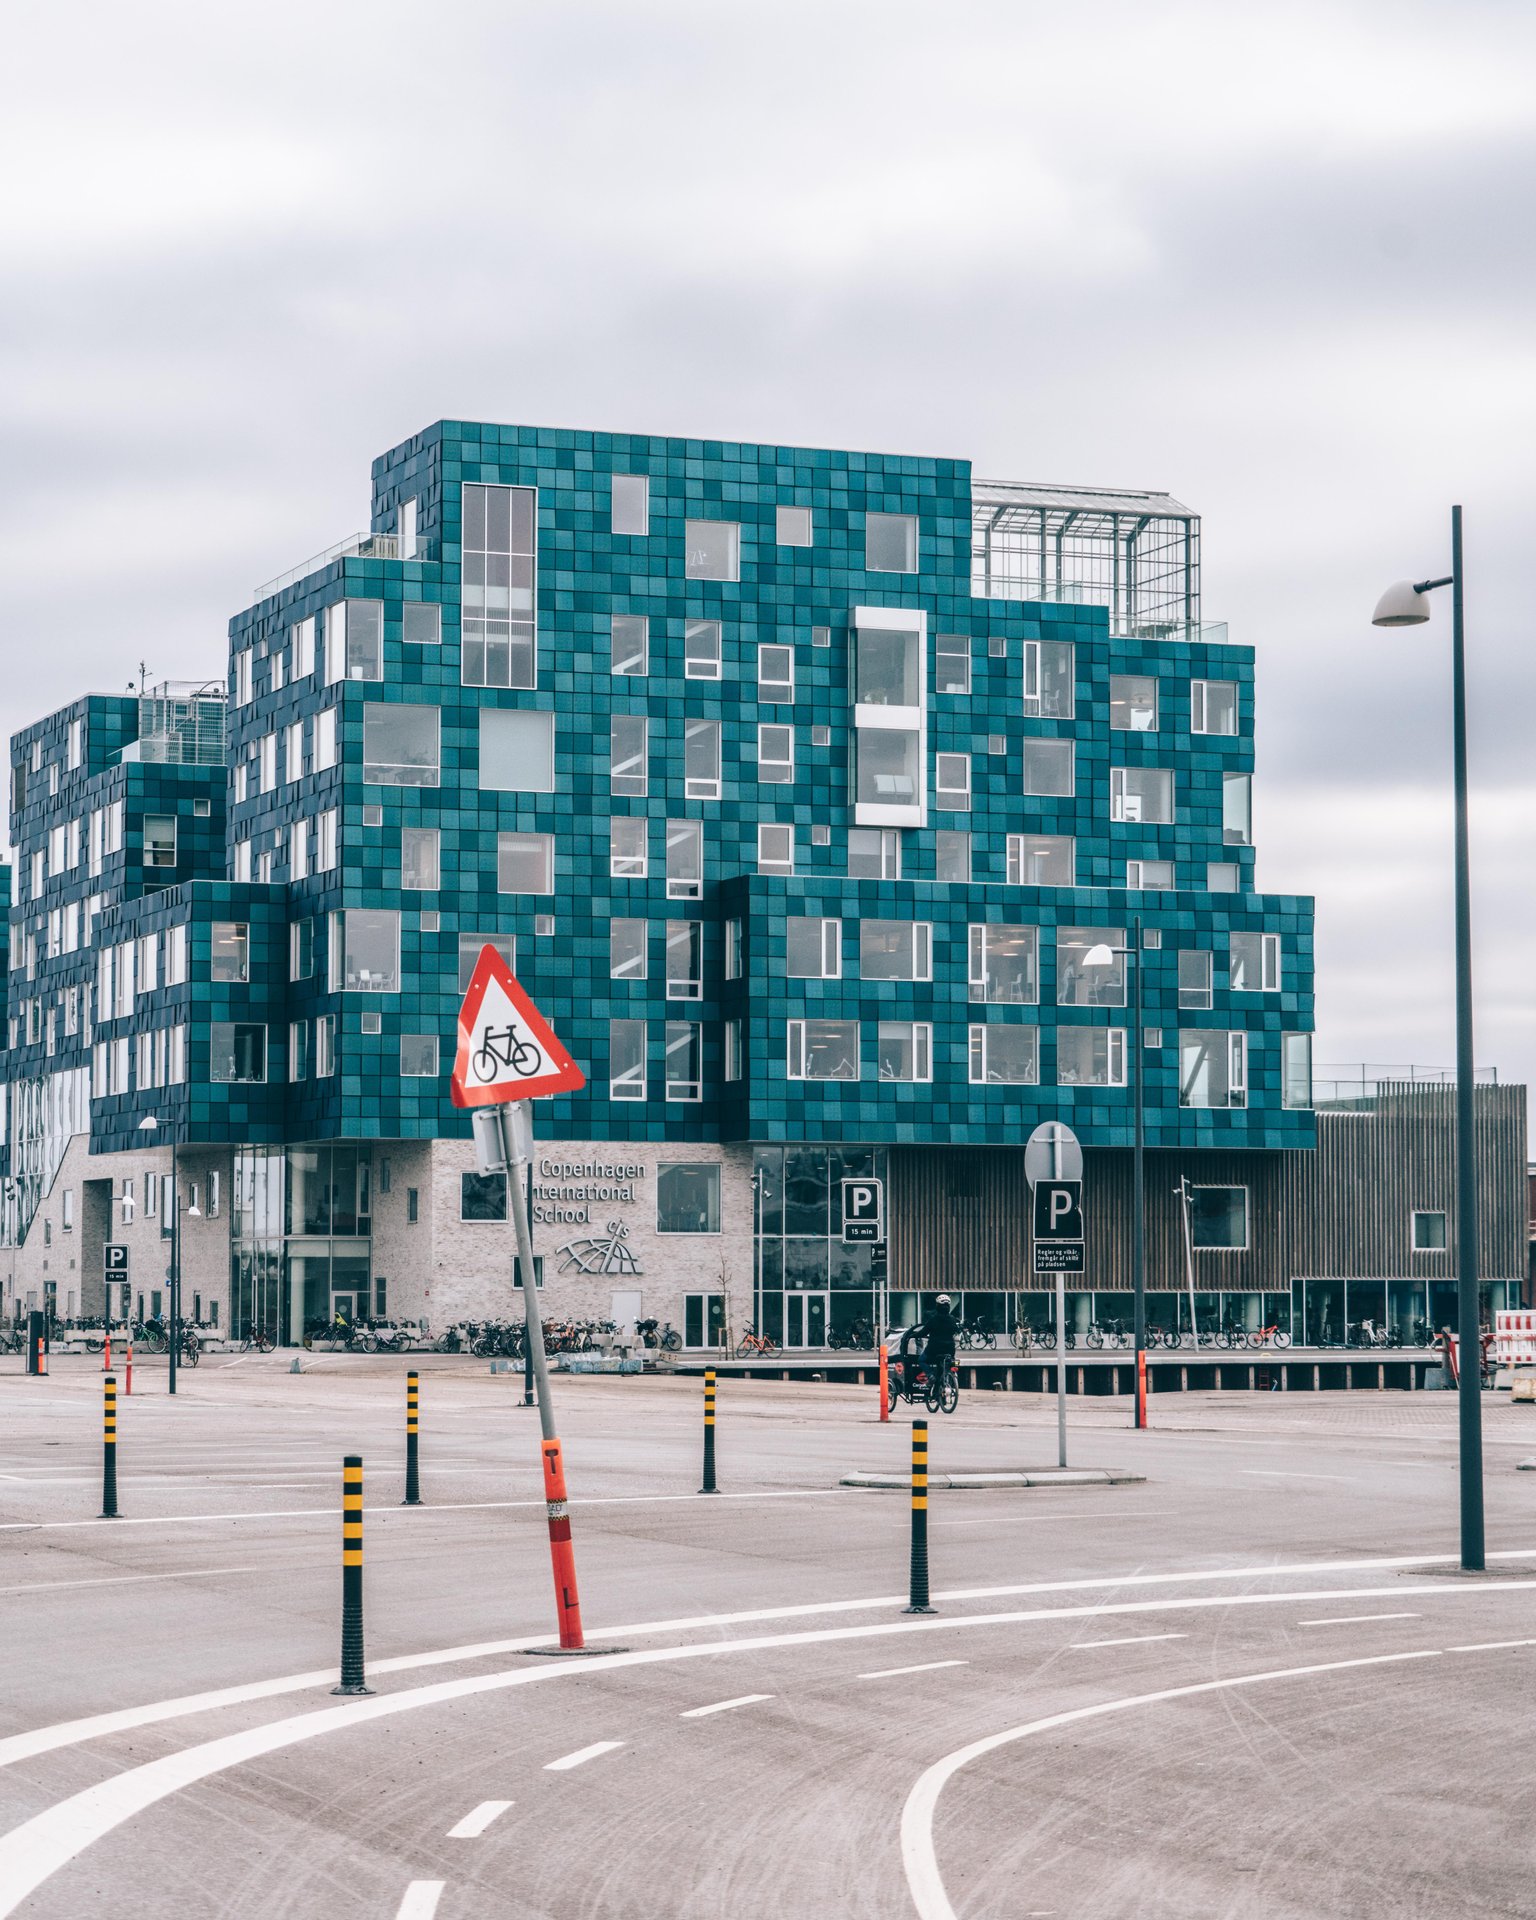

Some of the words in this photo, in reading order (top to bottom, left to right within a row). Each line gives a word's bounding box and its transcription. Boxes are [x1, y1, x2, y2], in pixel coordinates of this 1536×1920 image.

[541, 1158, 646, 1182] Copenhagen
[853, 1187, 872, 1216] P
[1050, 1190, 1073, 1230] P
[533, 1205, 592, 1224] School
[110, 1248, 124, 1267] P
